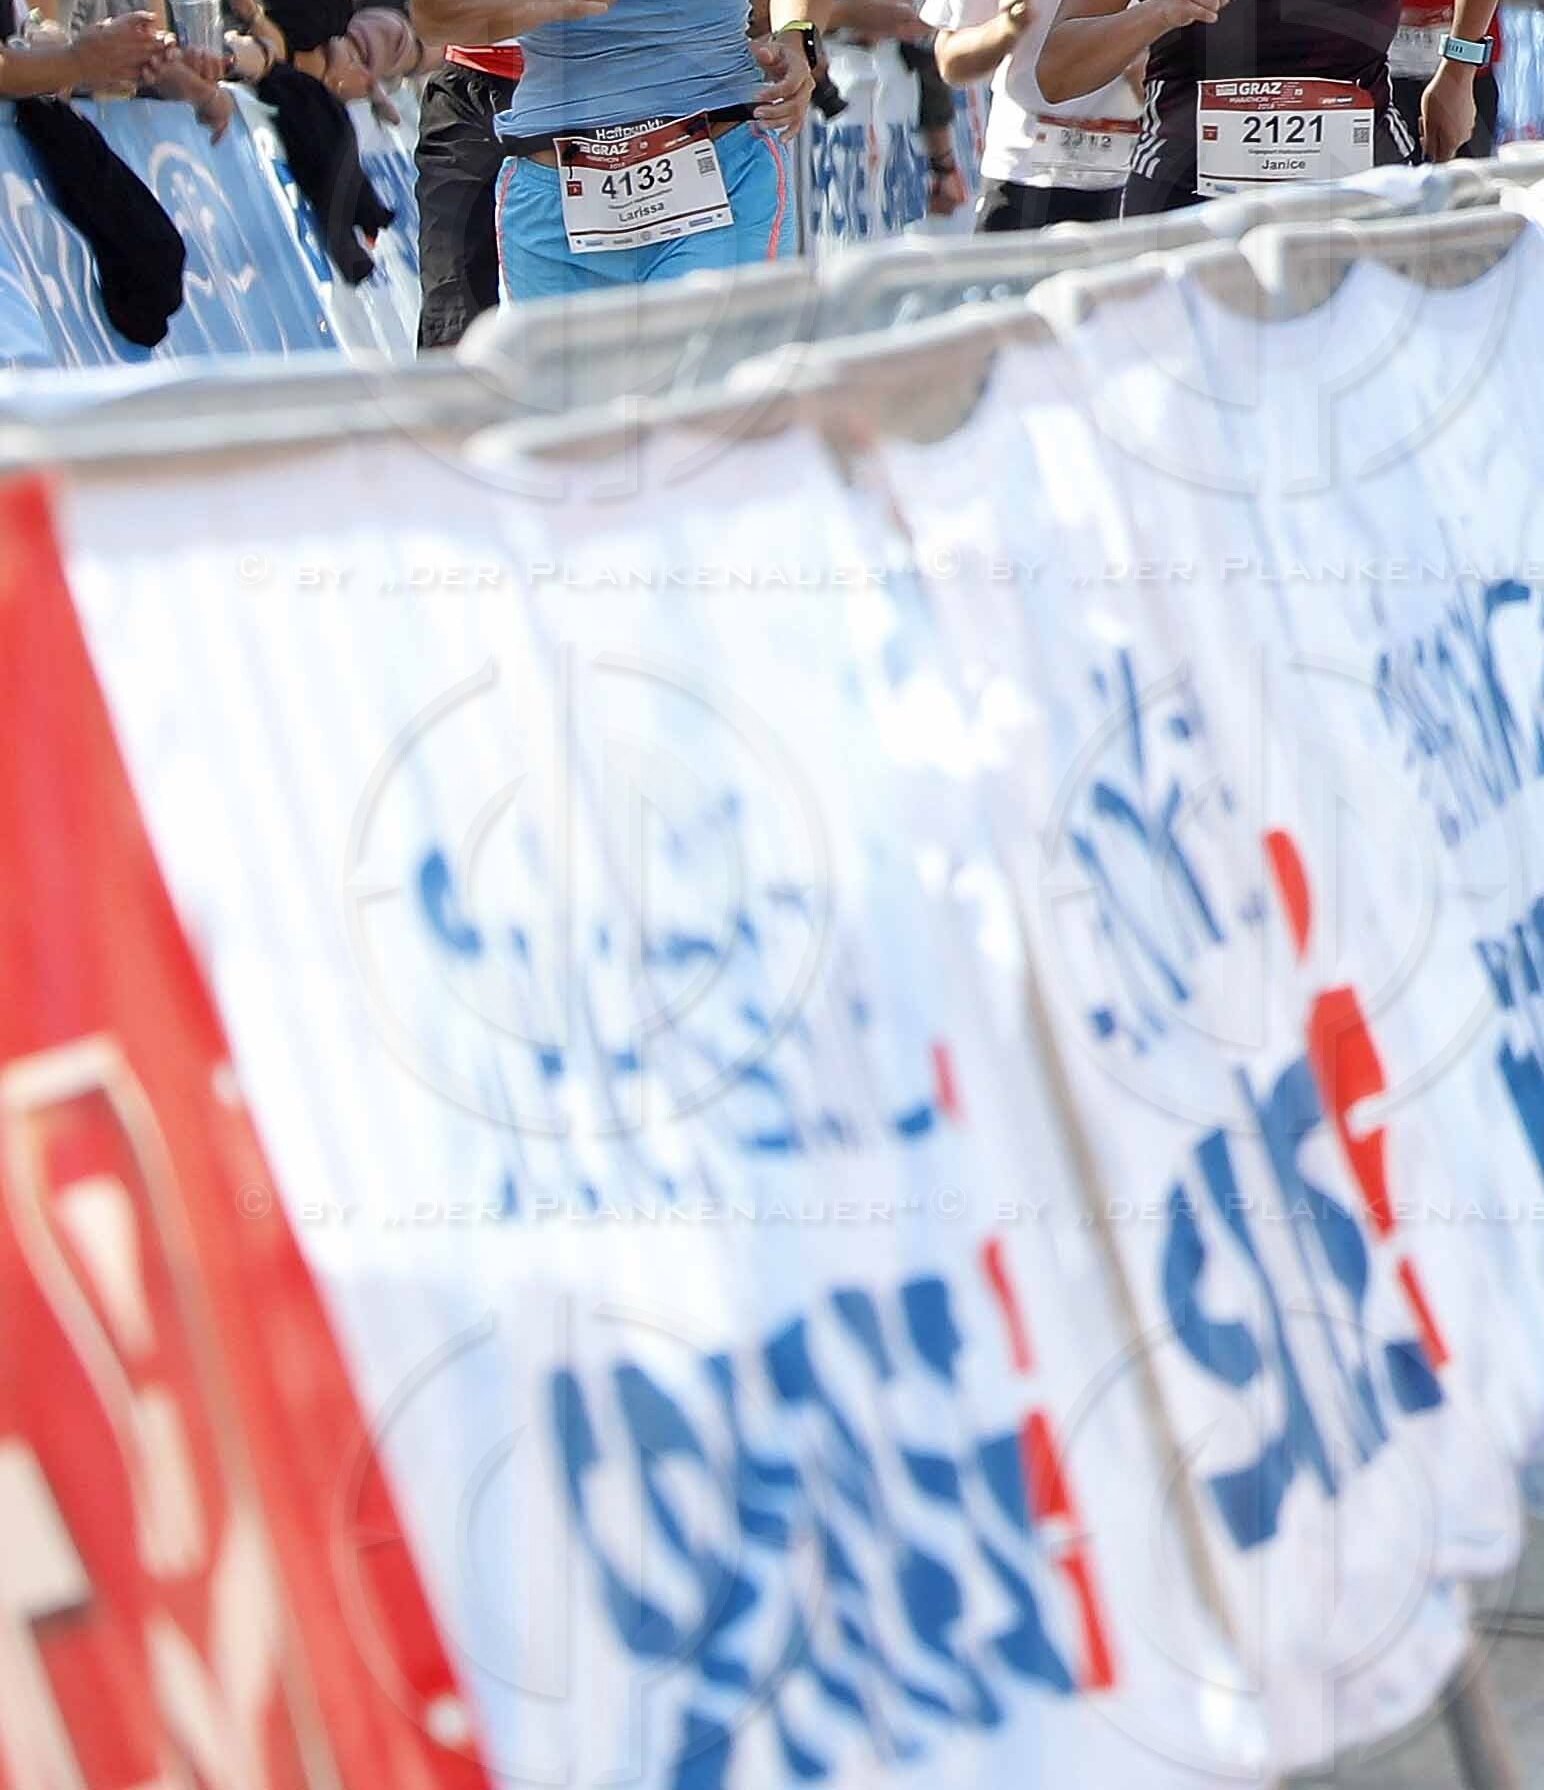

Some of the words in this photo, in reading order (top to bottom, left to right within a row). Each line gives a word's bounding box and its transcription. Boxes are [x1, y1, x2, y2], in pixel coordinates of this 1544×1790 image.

[1239, 82, 1281, 95] GRAZ
[1243, 115, 1323, 143] 2121
[591, 141, 629, 156] GRAZ
[1262, 160, 1306, 170] Janice
[601, 158, 674, 200] 4133
[618, 201, 665, 223] Larissa
